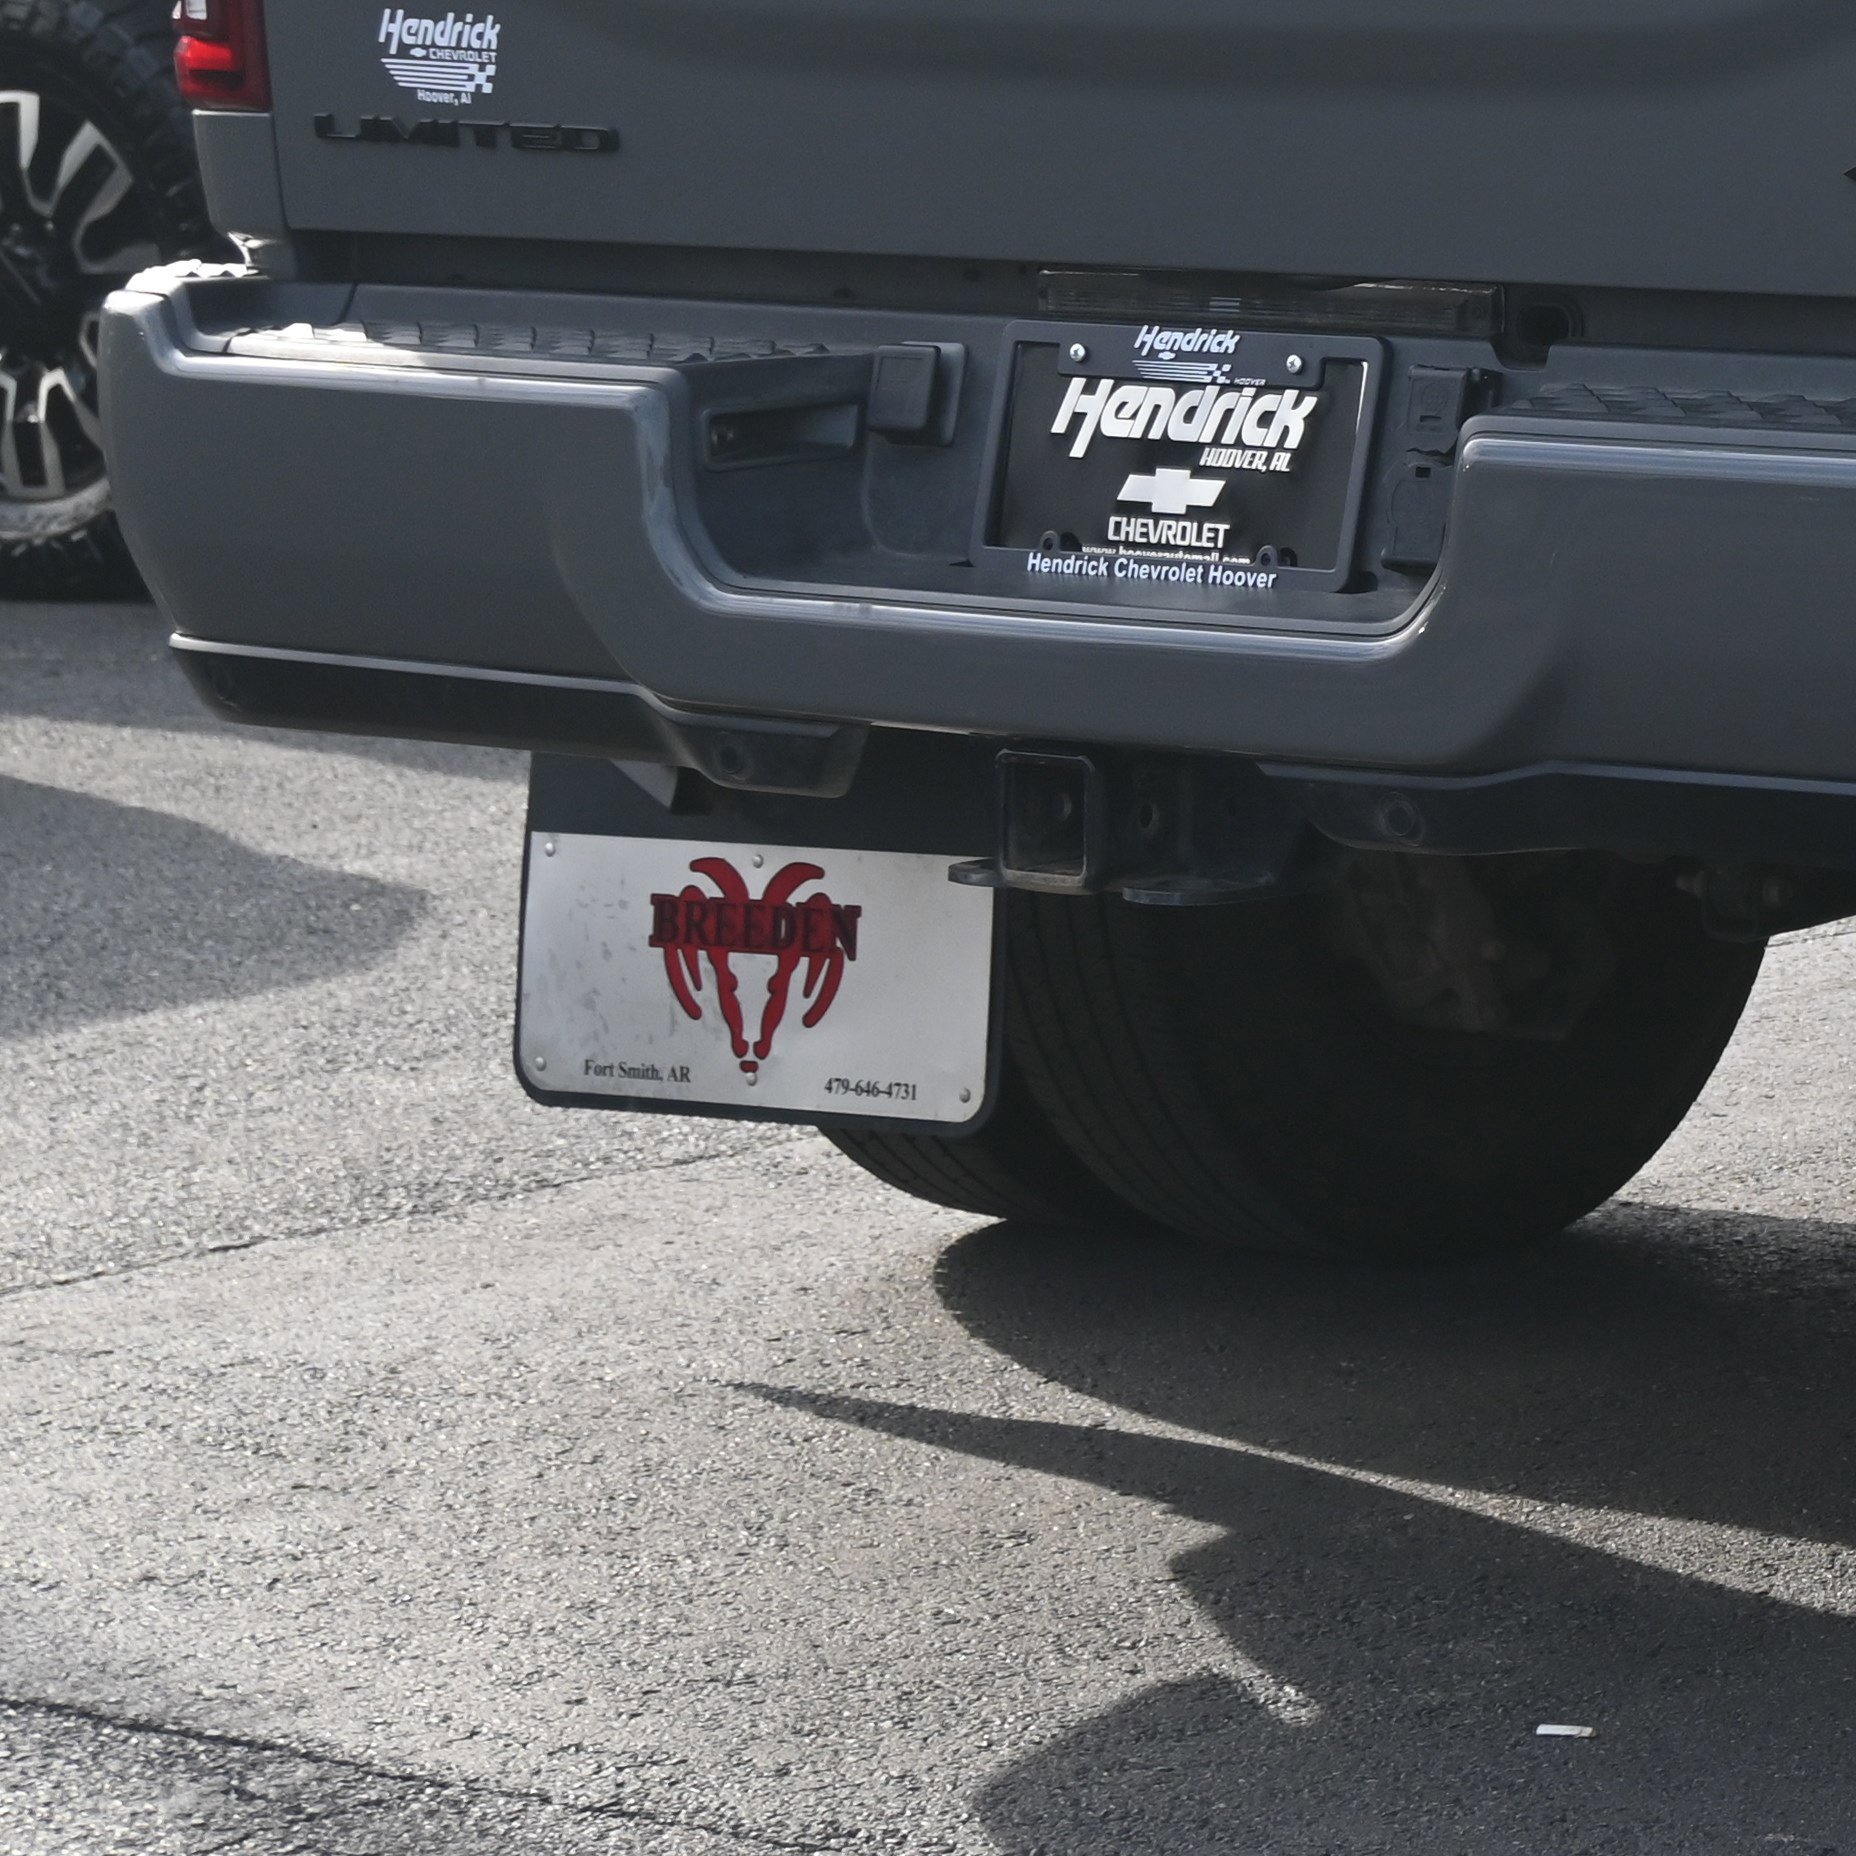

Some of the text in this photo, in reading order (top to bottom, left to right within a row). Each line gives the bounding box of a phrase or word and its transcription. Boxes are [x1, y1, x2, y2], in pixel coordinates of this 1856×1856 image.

[378, 8, 501, 55] Hendrick
[428, 47, 498, 63] CHEVROLET
[416, 88, 460, 106] Hoover,
[313, 112, 621, 152] LIMITED
[1133, 324, 1241, 357] Hendrick
[1233, 377, 1267, 387] HOOVER
[1050, 377, 1318, 459] Hendrick
[1199, 447, 1292, 473] HOOVER, AL
[1107, 515, 1231, 549] CHEVROLET
[1027, 551, 1278, 589] Hendrick Chevrolet Hoover
[648, 892, 862, 962] BREEDEN
[583, 1059, 692, 1083] Fort Smith, AR
[824, 1076, 918, 1101] 479-646-4731
